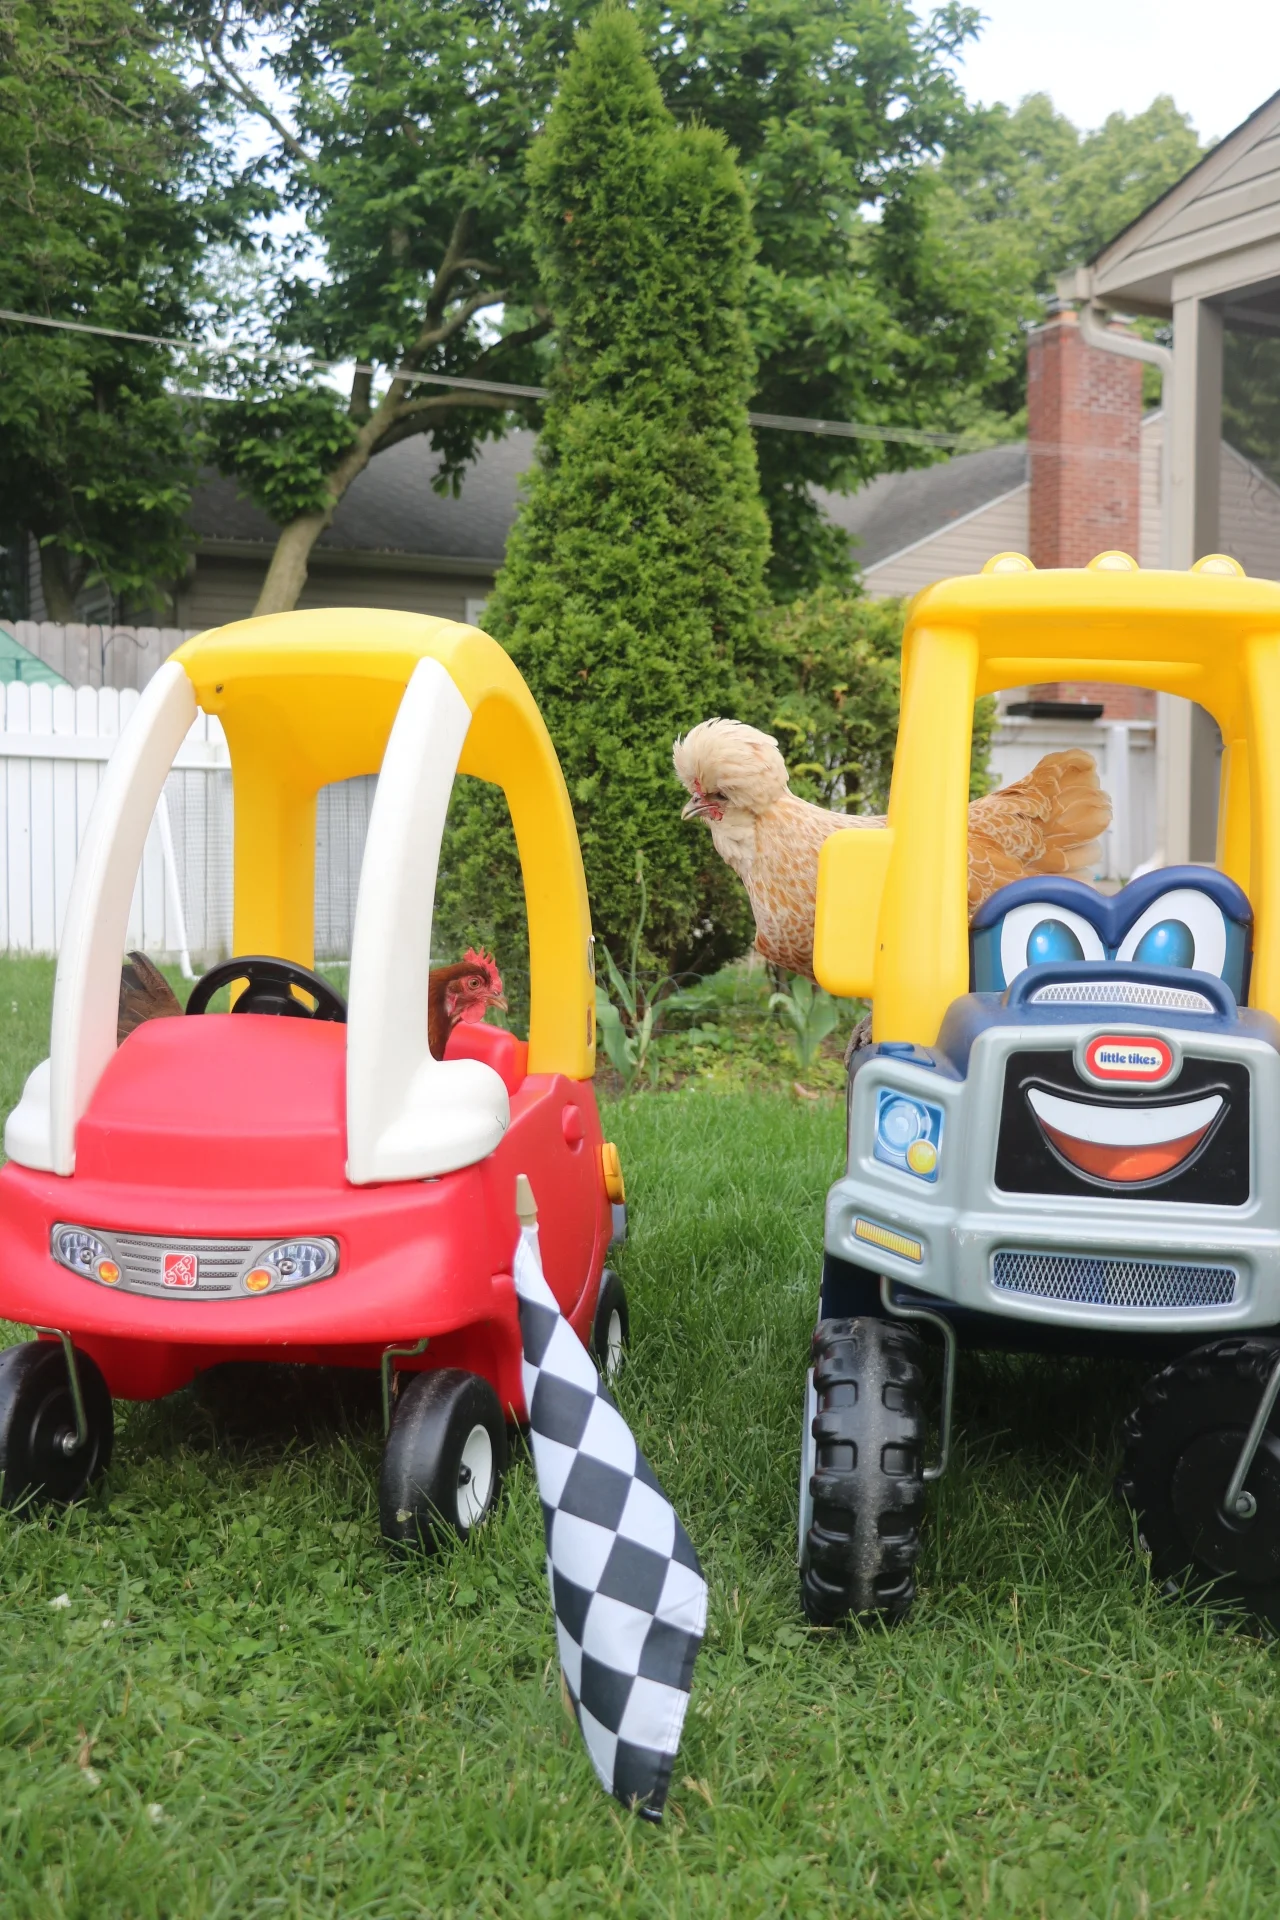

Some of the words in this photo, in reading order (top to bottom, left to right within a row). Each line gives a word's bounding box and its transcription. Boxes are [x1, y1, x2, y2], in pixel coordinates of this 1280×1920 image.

[1100, 1052, 1126, 1064] little
[1128, 1053, 1156, 1065] tikes
[164, 1255, 192, 1285] STEP
